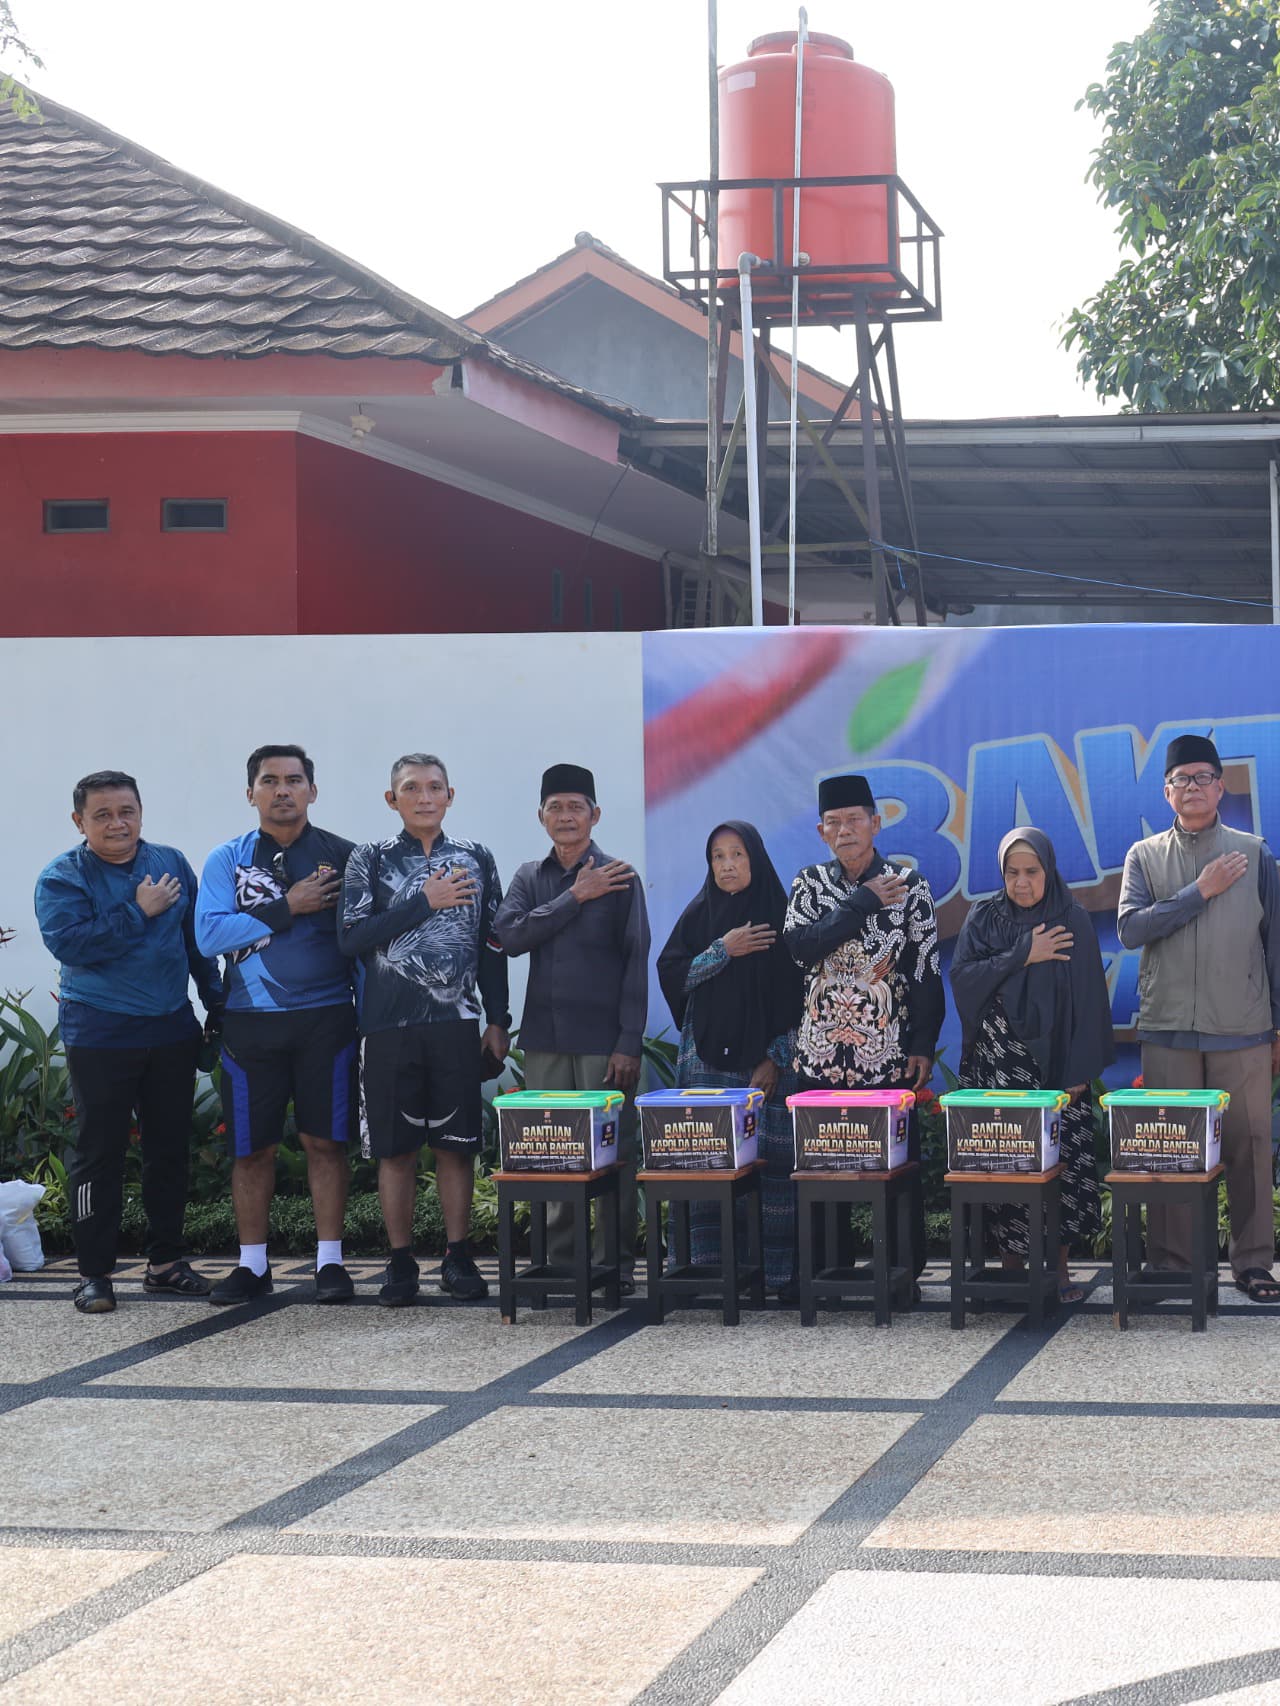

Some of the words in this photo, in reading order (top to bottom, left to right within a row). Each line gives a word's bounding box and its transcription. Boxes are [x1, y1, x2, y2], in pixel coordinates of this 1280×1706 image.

[522, 1125, 572, 1142] BANTUAN
[664, 1122, 713, 1139] BANTUAN
[818, 1122, 869, 1139] BANTUAN
[971, 1122, 1022, 1139] BANTUAN
[1135, 1122, 1187, 1140] BANTUAN
[509, 1142, 549, 1155] KAPOLDA
[550, 1142, 585, 1155] BANTEN
[651, 1139, 691, 1152] KAPOLDA
[692, 1138, 727, 1152] BANTEN
[804, 1139, 844, 1152] KAPOLDA
[845, 1140, 881, 1153] BANTEN
[957, 1139, 997, 1152] KAPOLDA
[999, 1140, 1035, 1153] BANTEN
[1120, 1138, 1160, 1152] KAPOLDA
[1162, 1140, 1200, 1154] BANTEN
